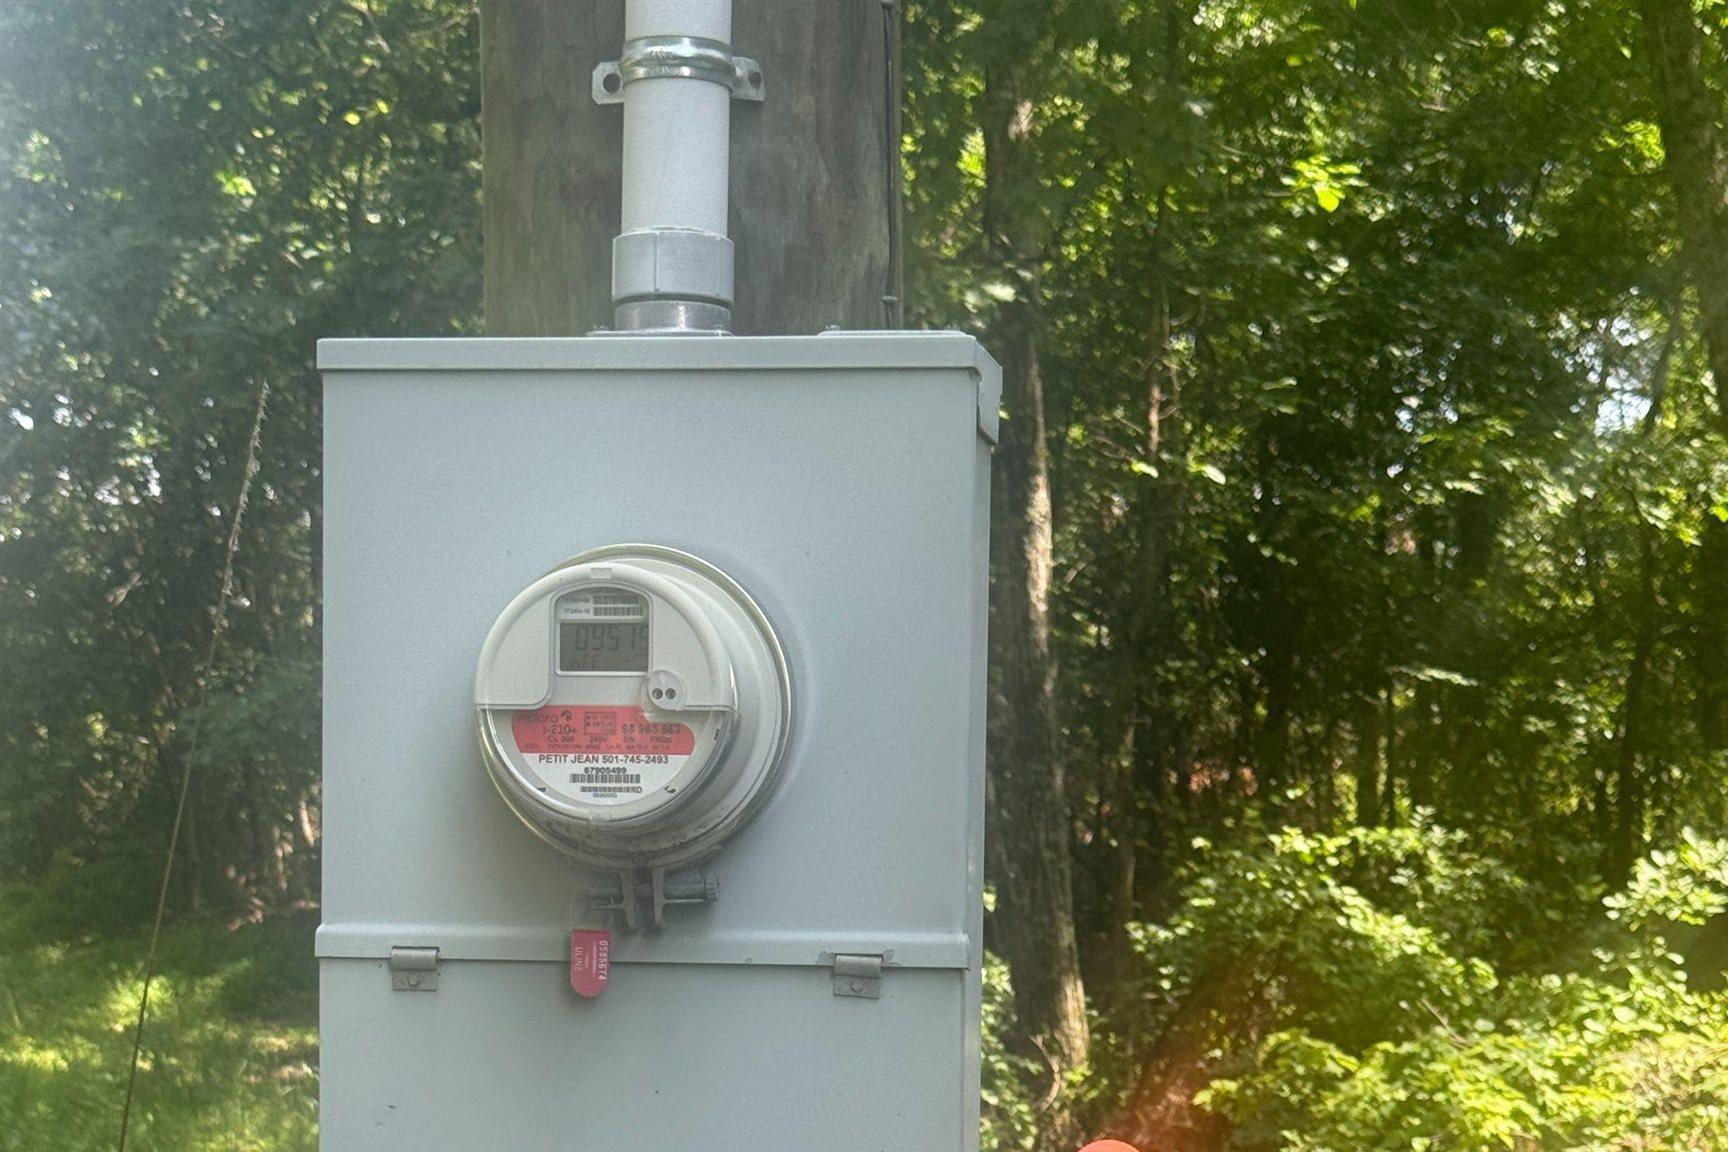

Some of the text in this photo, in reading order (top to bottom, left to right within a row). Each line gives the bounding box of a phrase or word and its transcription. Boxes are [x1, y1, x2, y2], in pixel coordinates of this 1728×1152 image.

[538, 755, 669, 764] PETIT JEAN 501-745-2493
